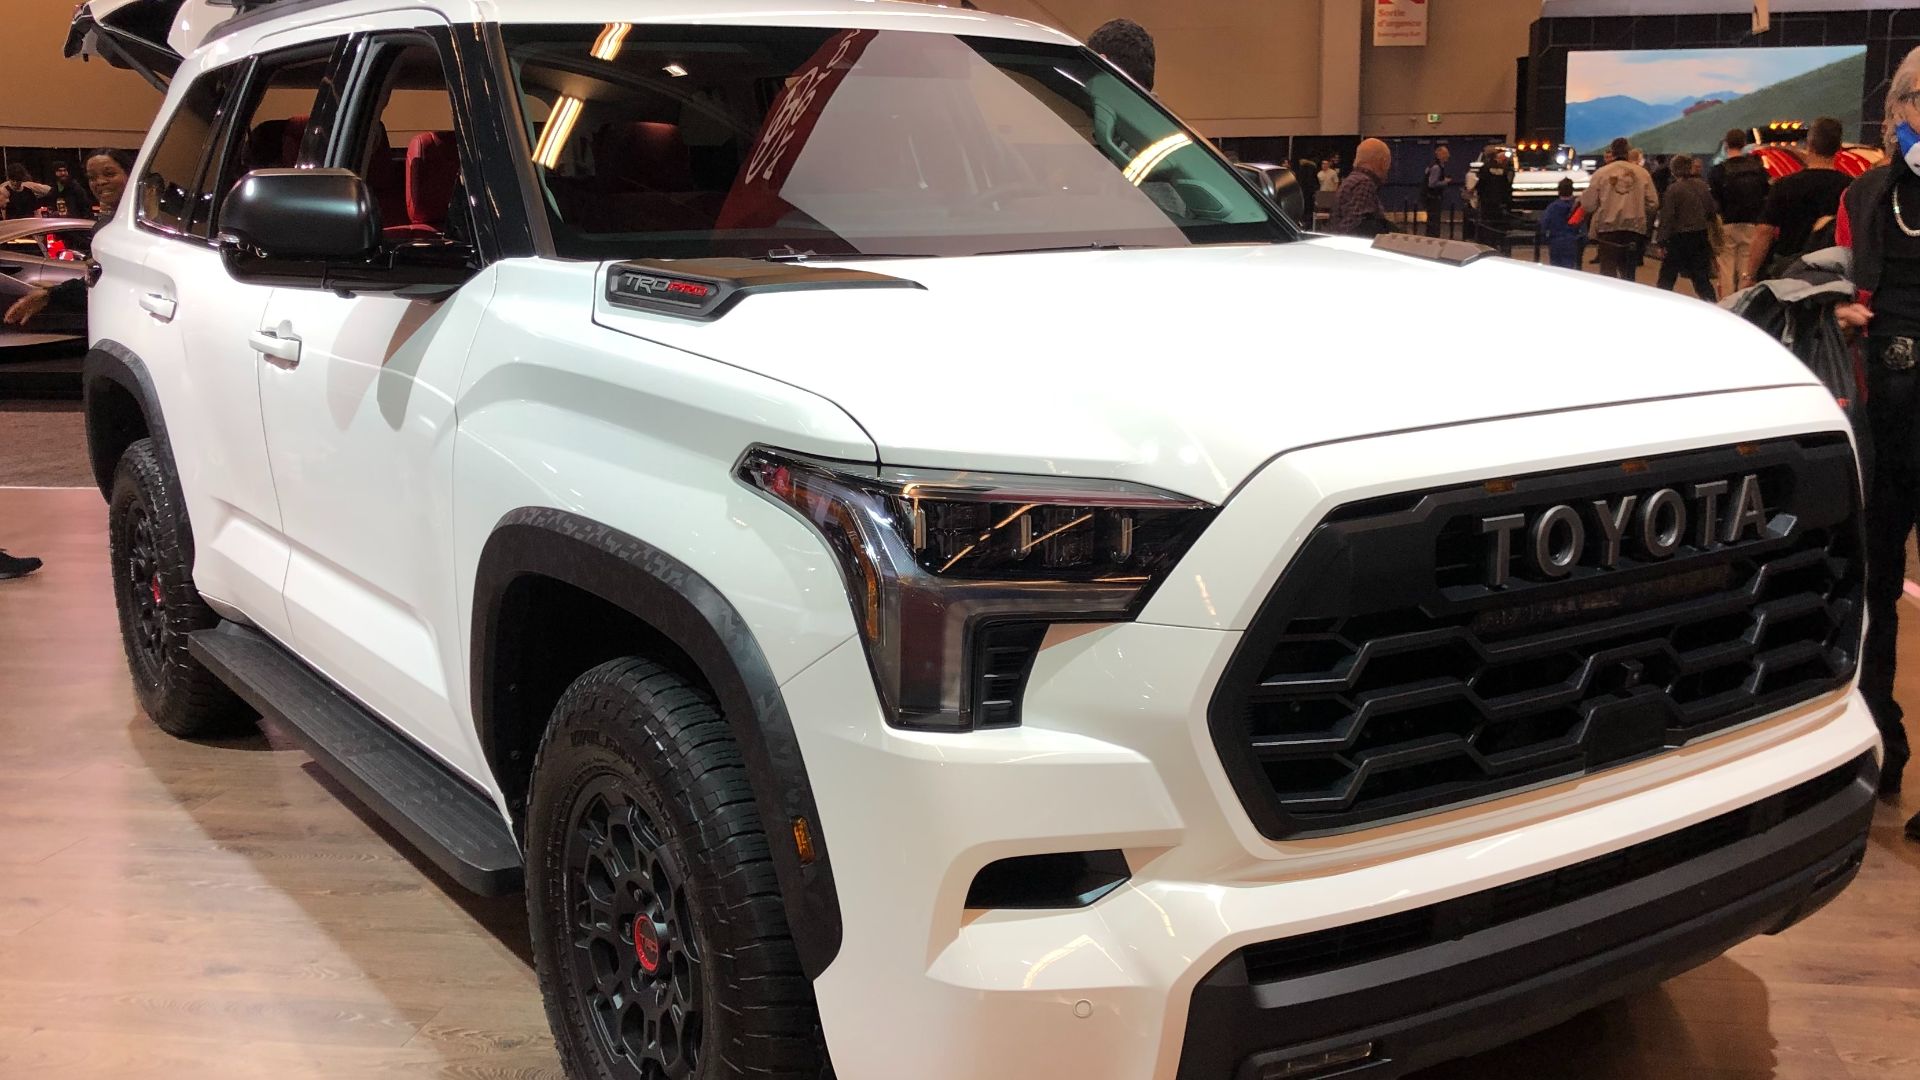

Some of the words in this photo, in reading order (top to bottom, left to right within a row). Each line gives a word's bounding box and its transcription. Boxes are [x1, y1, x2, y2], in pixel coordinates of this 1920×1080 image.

[1378, 9, 1406, 17] Sortie
[625, 273, 670, 294] TRD
[1482, 475, 1768, 586] TOYOTA
